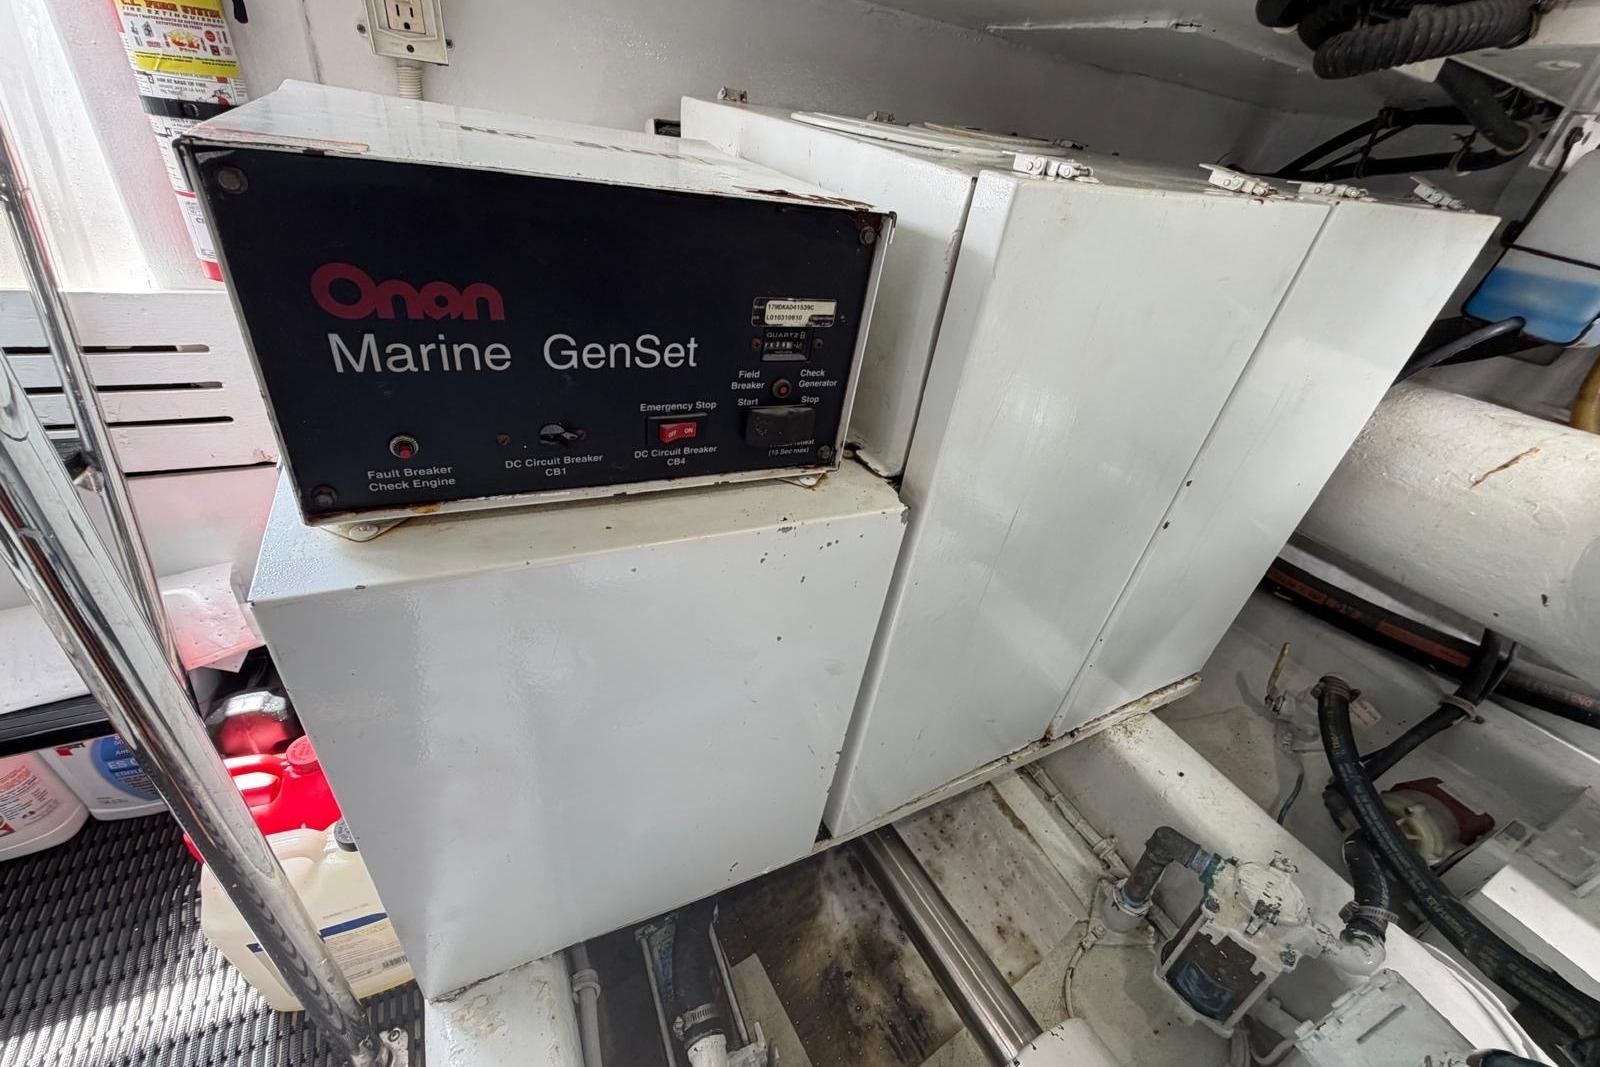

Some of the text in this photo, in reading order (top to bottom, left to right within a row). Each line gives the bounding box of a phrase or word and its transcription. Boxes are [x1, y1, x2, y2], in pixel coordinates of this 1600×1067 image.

[310, 262, 505, 321] Onan
[327, 333, 698, 373] Marine GenSet
[738, 370, 760, 379] Field
[800, 368, 825, 377] Check
[731, 381, 765, 390] Breaker
[798, 379, 838, 388] Generator
[737, 398, 759, 406] Start
[801, 395, 820, 404] Stop
[639, 400, 717, 412] Emergency Stop
[683, 427, 694, 435] ON
[634, 445, 717, 459] DC Circuit Breaker
[505, 454, 603, 469] DC Circuit Breaker
[666, 457, 686, 466] CB4
[367, 466, 453, 480] Fault Breaker
[545, 467, 567, 477] CB1
[368, 478, 456, 492] Check Engine
